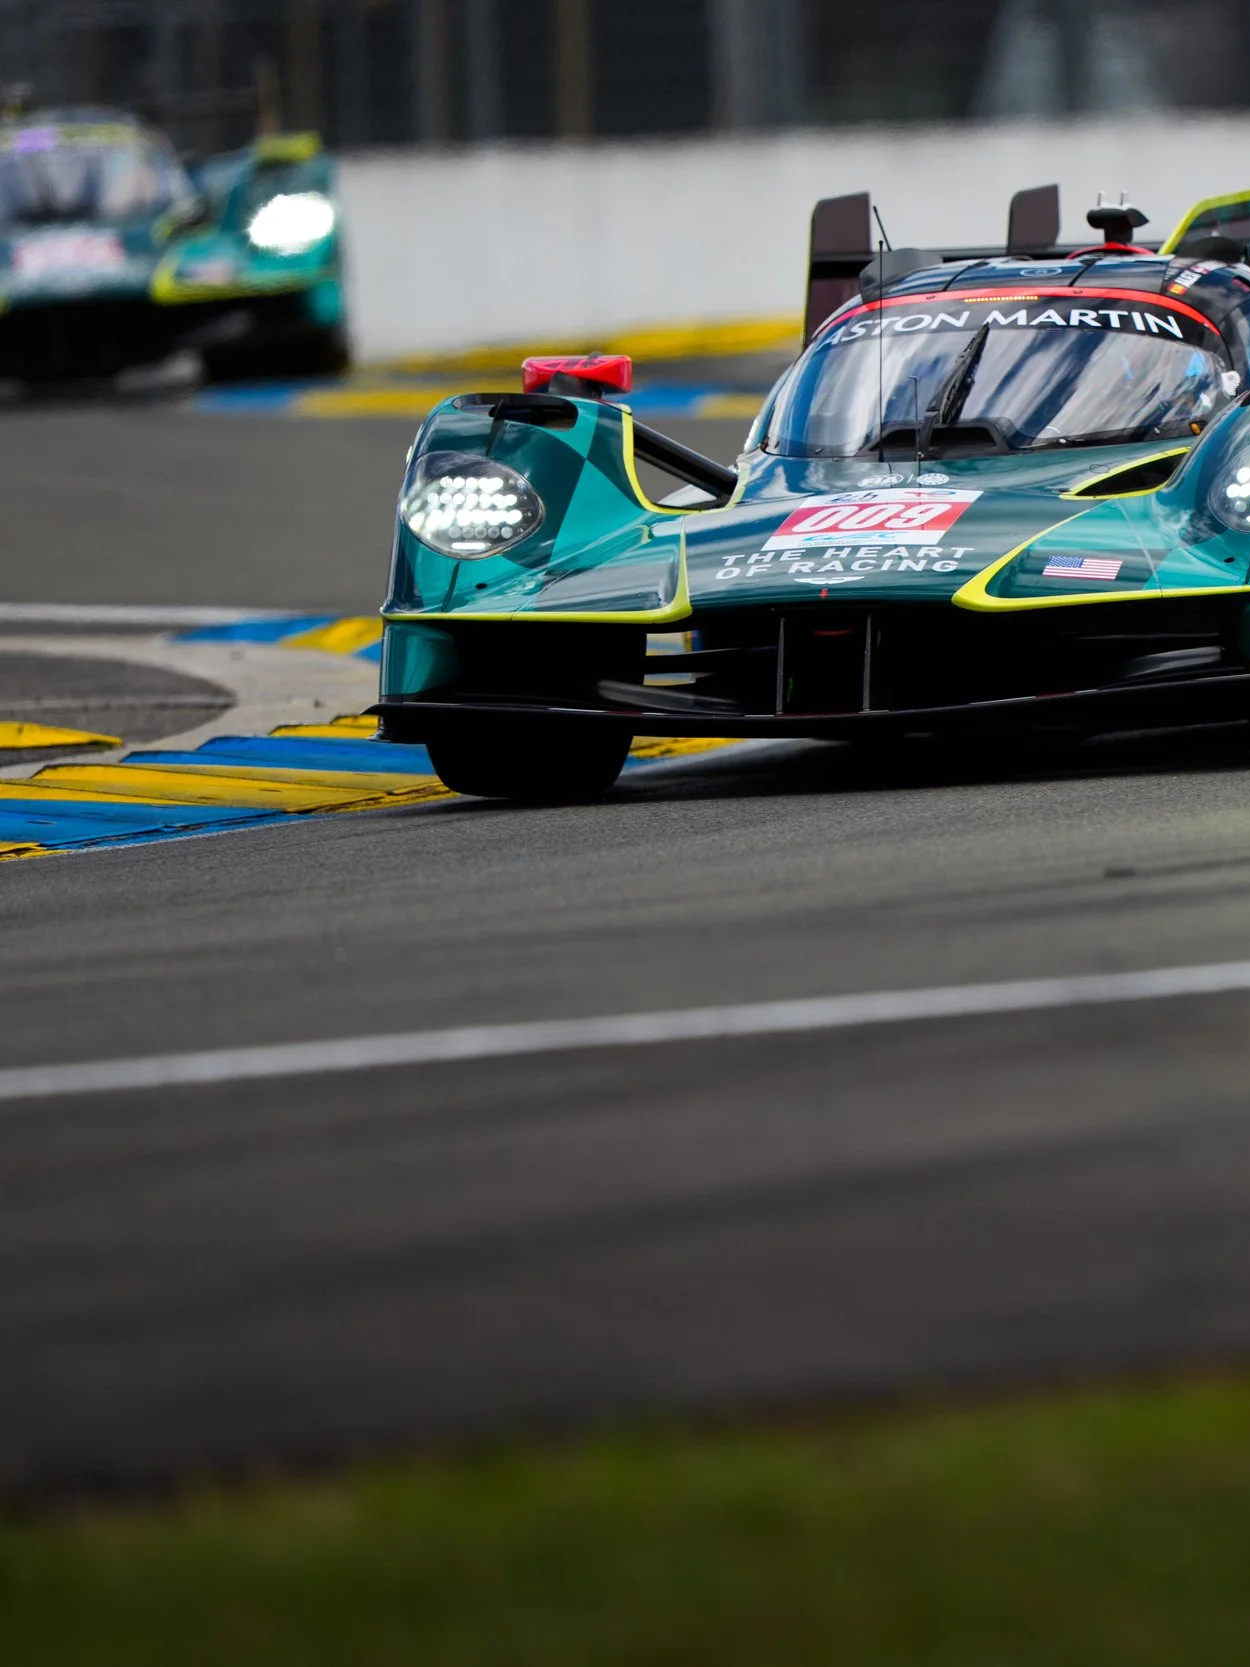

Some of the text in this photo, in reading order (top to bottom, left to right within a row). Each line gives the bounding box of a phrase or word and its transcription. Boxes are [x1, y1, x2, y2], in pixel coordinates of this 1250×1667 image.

[815, 308, 1184, 351] ASTON MARTIN
[792, 503, 953, 533] 009
[722, 546, 976, 567] THE HEART
[715, 559, 960, 580] OF RACING
